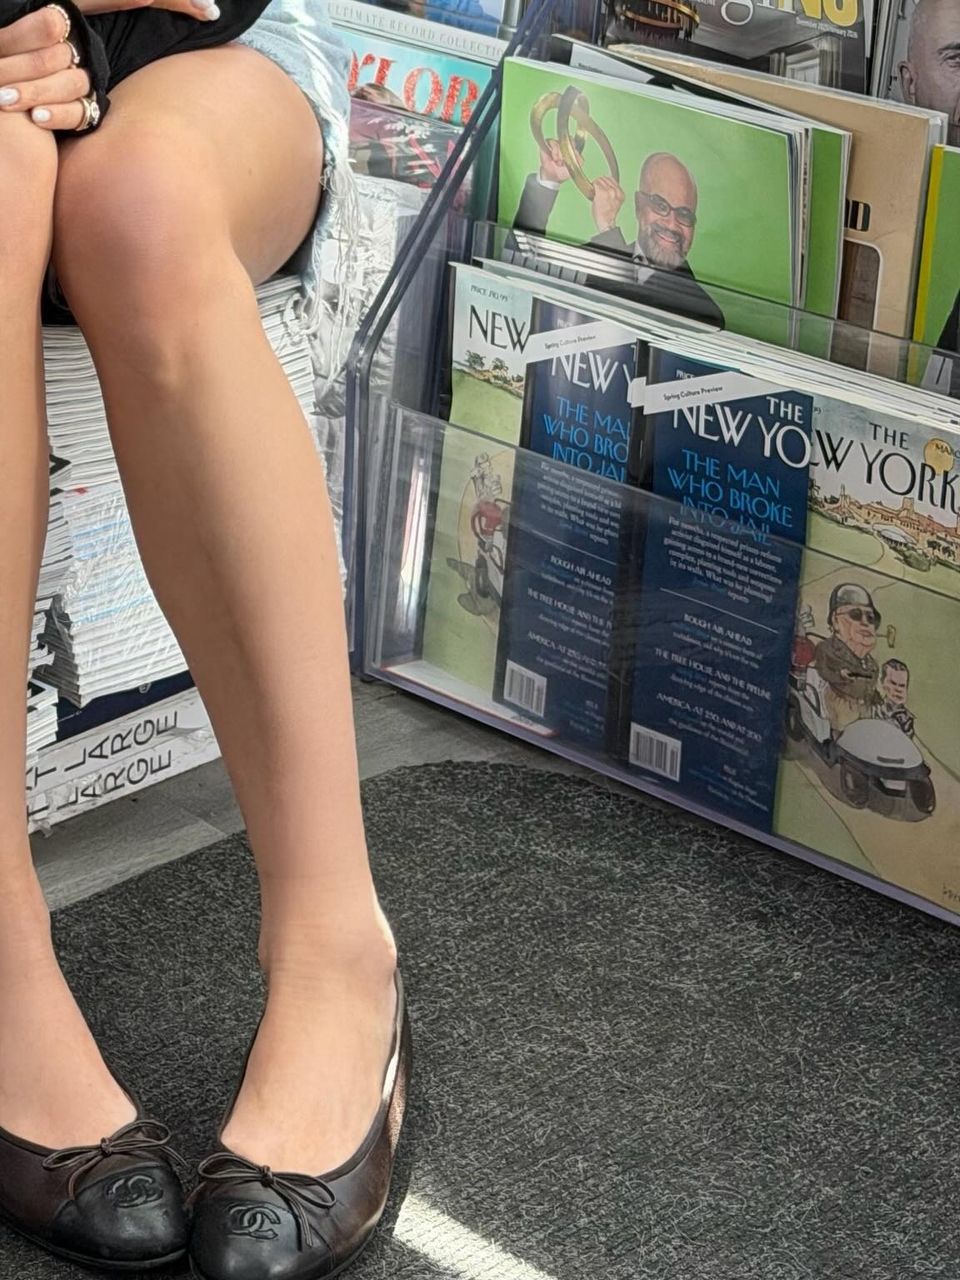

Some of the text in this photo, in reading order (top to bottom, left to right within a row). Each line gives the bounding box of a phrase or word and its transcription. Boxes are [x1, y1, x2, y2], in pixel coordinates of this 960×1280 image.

[388, 14, 436, 42] RECORD
[469, 304, 531, 355] NEW
[552, 349, 618, 394] NEW
[663, 384, 724, 402] Spring Culture Preview
[556, 395, 588, 420] THE
[766, 395, 804, 424] THE
[543, 413, 628, 462] WHO BRO
[673, 402, 814, 470] NEW YO
[869, 421, 911, 451] THE
[667, 466, 724, 505] WHO
[730, 491, 793, 528] BROKE
[681, 447, 781, 500] THE MAN
[680, 496, 730, 528] INTO
[63, 710, 179, 773] LARGE
[55, 749, 173, 811] LARGE
